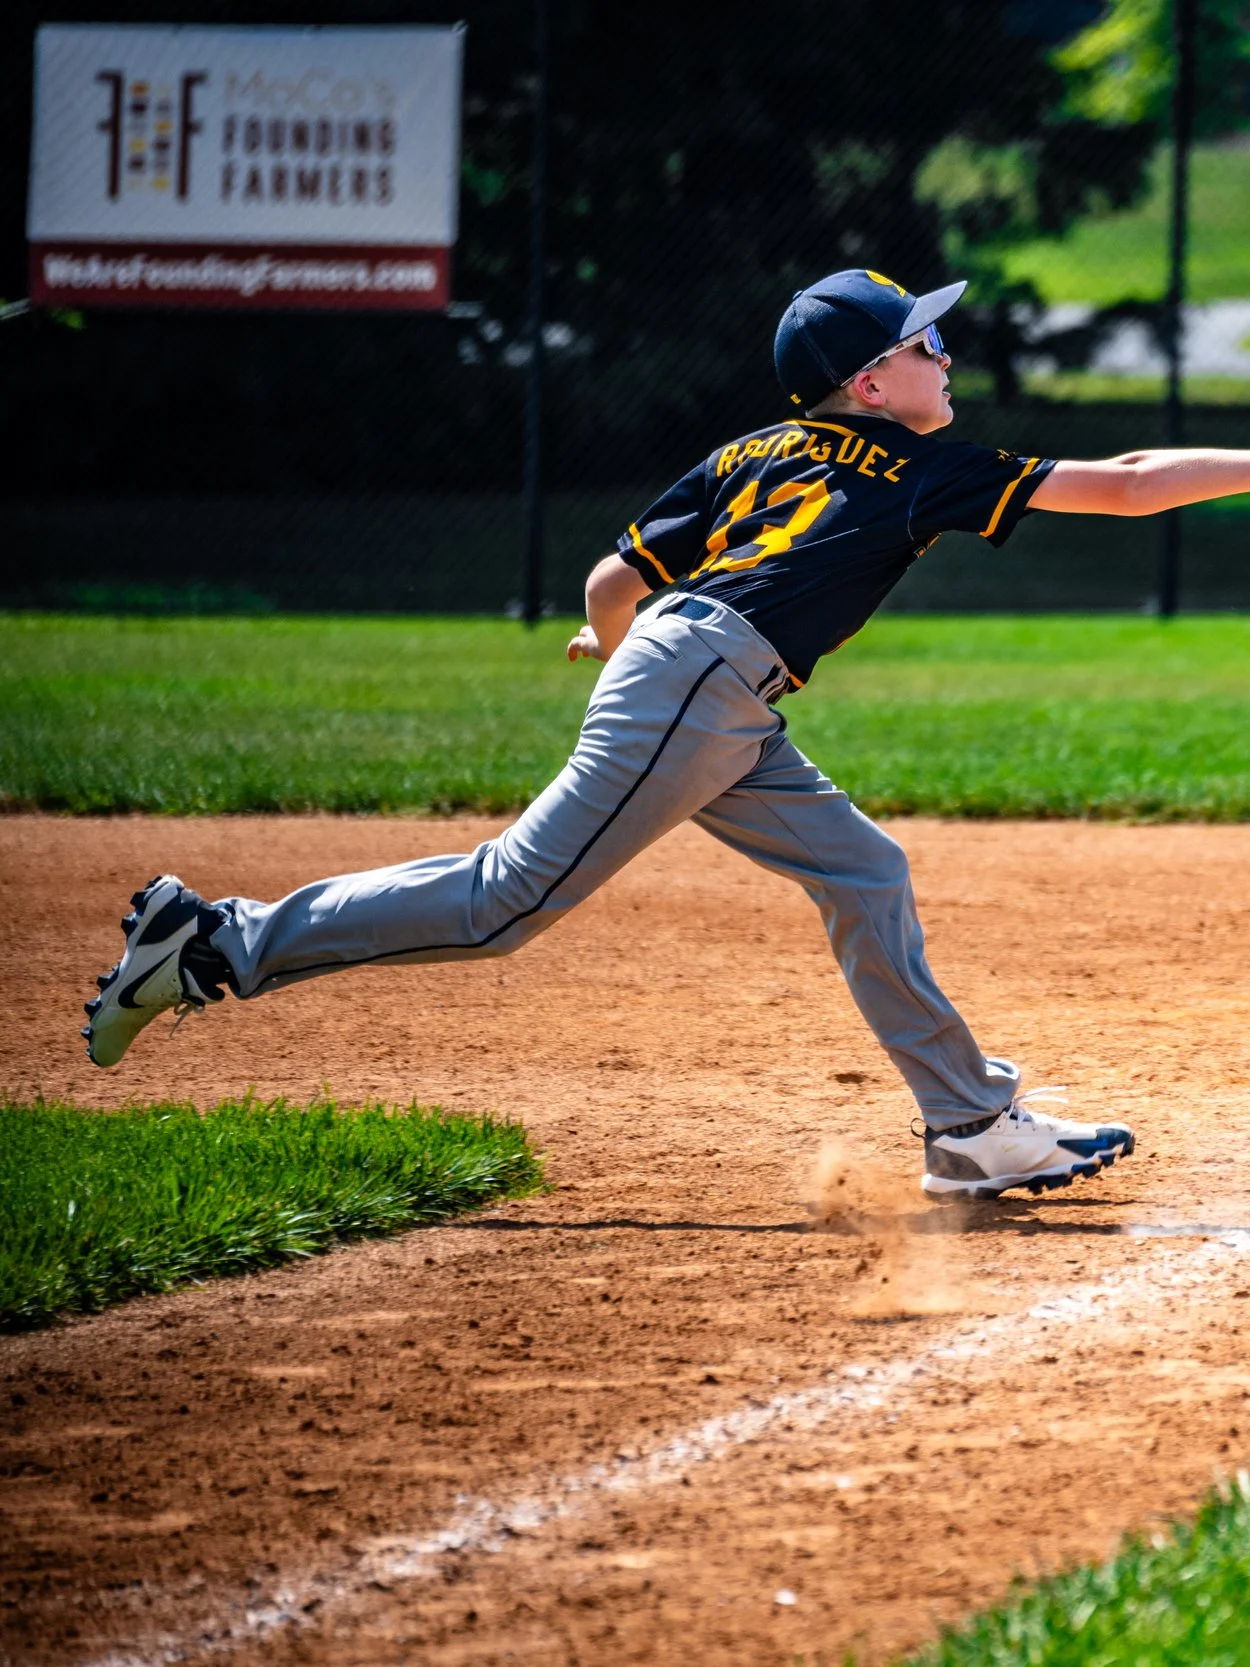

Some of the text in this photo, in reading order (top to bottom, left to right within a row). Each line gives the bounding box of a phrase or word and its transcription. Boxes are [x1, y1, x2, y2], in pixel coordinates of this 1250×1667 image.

[223, 117, 396, 156] FOUNDING
[222, 163, 395, 203] FARMERS
[716, 430, 911, 483] RODRIGUEZ
